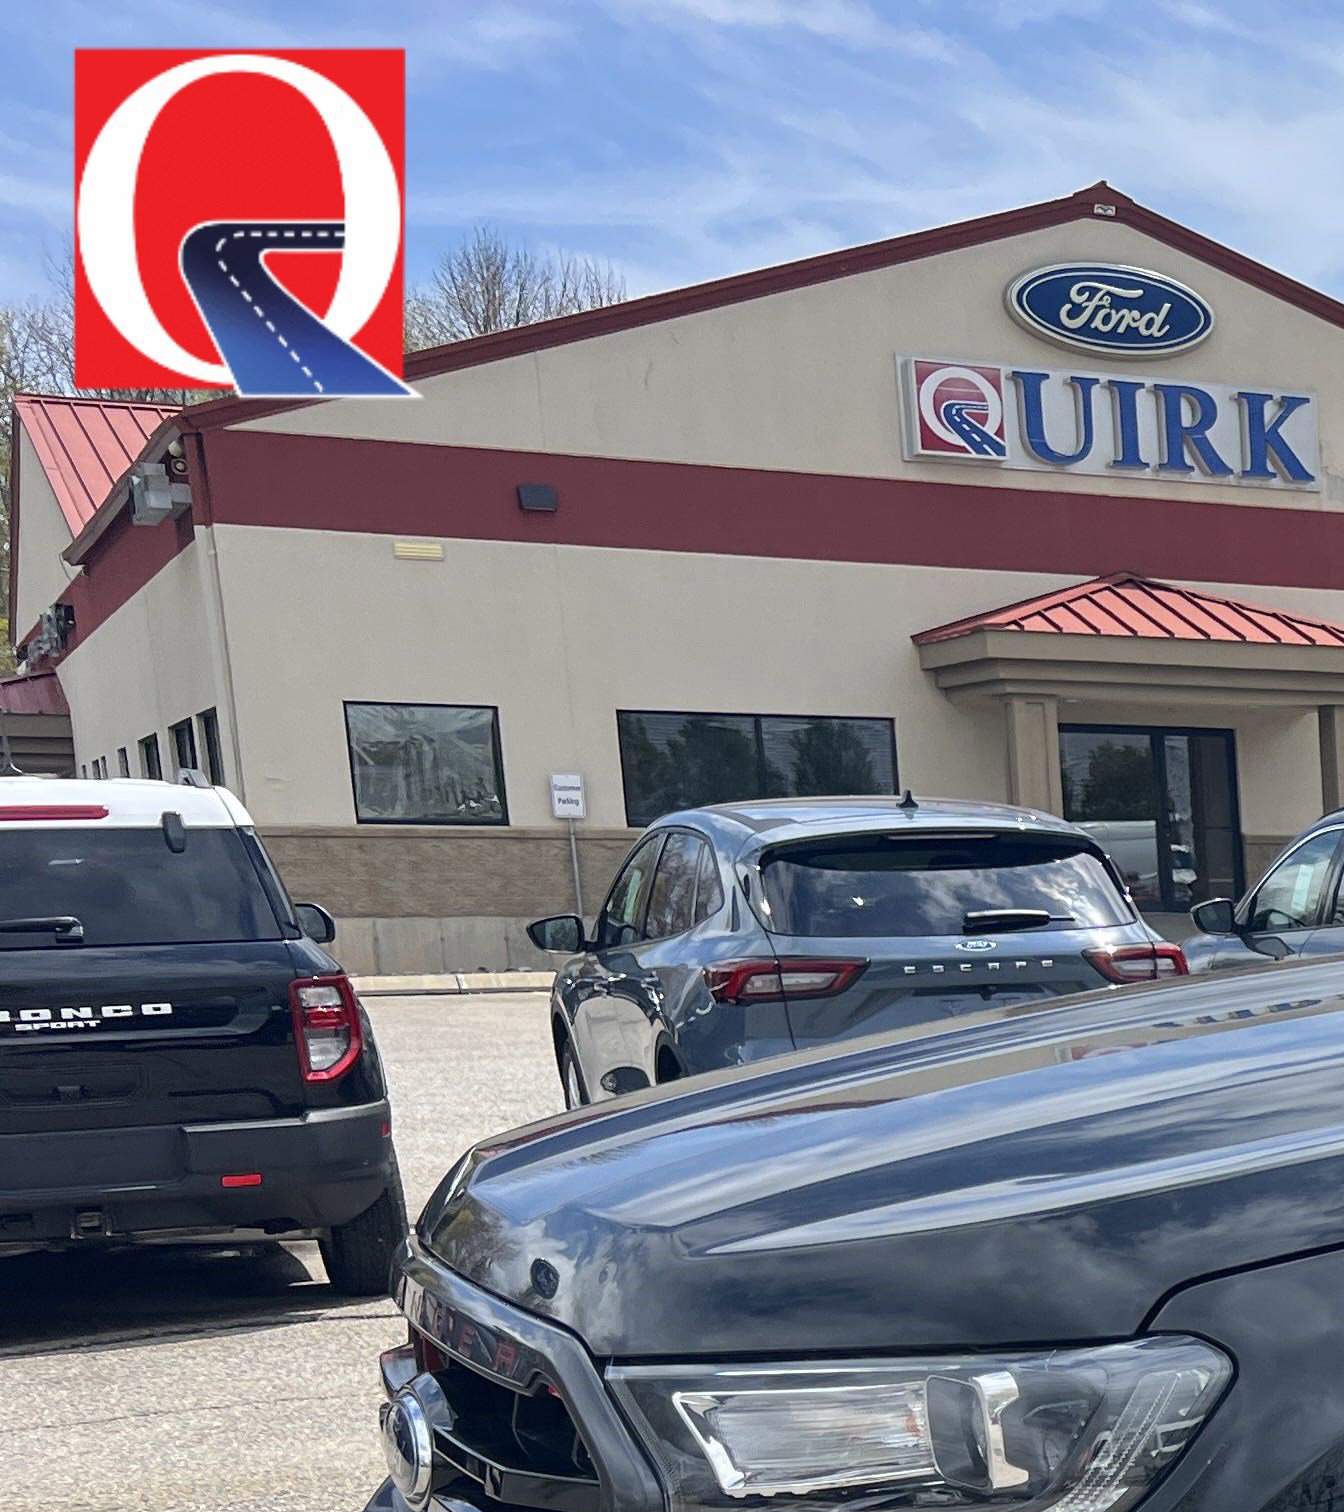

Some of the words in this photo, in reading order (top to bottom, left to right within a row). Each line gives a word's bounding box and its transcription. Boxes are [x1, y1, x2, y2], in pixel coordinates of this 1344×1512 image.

[1058, 281, 1171, 338] Ford
[918, 366, 1315, 482] QUIRK
[904, 959, 1053, 974] ESCAPE
[15, 1019, 101, 1031] SPORT
